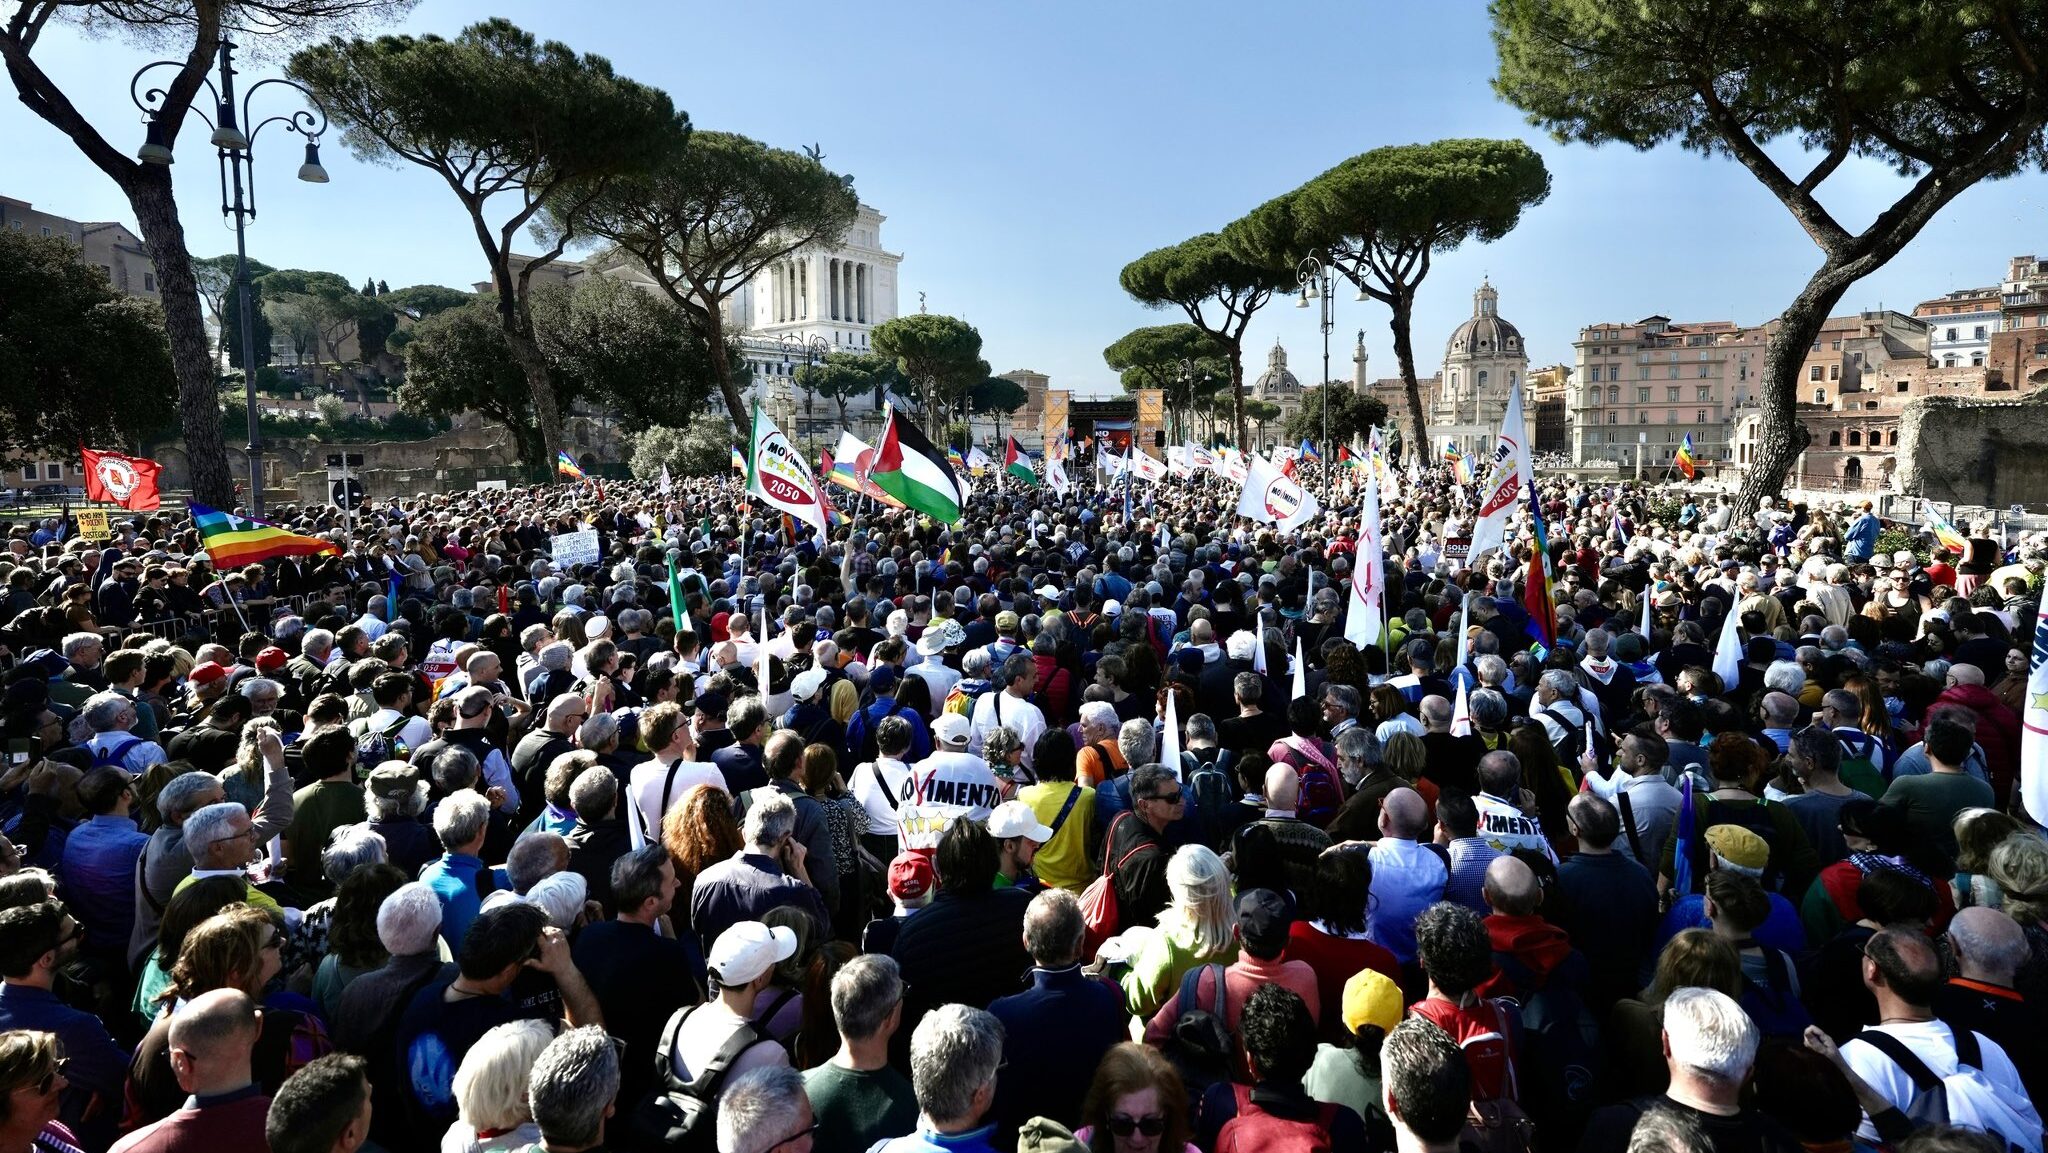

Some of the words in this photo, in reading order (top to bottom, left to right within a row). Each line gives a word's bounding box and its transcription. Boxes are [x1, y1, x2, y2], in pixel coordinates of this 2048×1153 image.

[770, 480, 800, 500] 2050
[1272, 486, 1298, 506] MOVIMENTO
[82, 530, 108, 540] SOSTEGNO
[424, 664, 440, 672] 050
